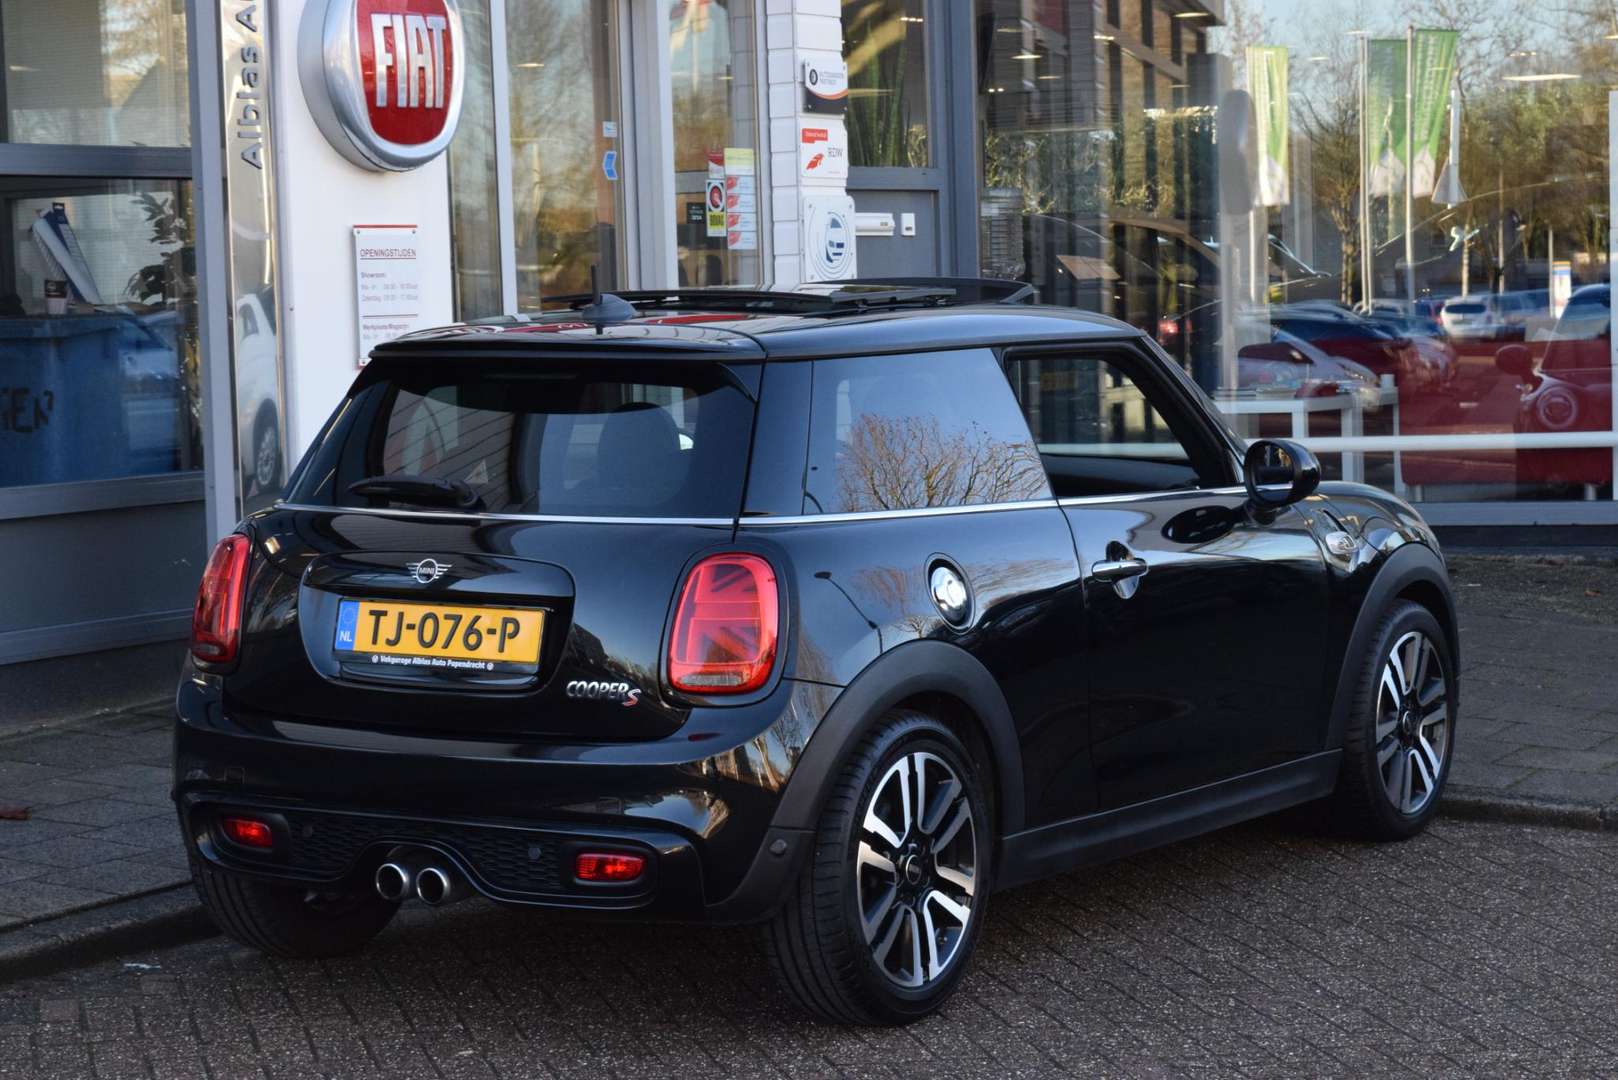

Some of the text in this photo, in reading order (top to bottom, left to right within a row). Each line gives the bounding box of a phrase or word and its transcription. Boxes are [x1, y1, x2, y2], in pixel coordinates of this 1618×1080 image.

[370, 13, 446, 109] FIAT
[236, 46, 263, 170] Alblas
[339, 630, 353, 643] NL
[368, 609, 521, 654] TJ-076-P
[432, 658, 447, 667] Auto
[566, 680, 629, 699] COOPER
